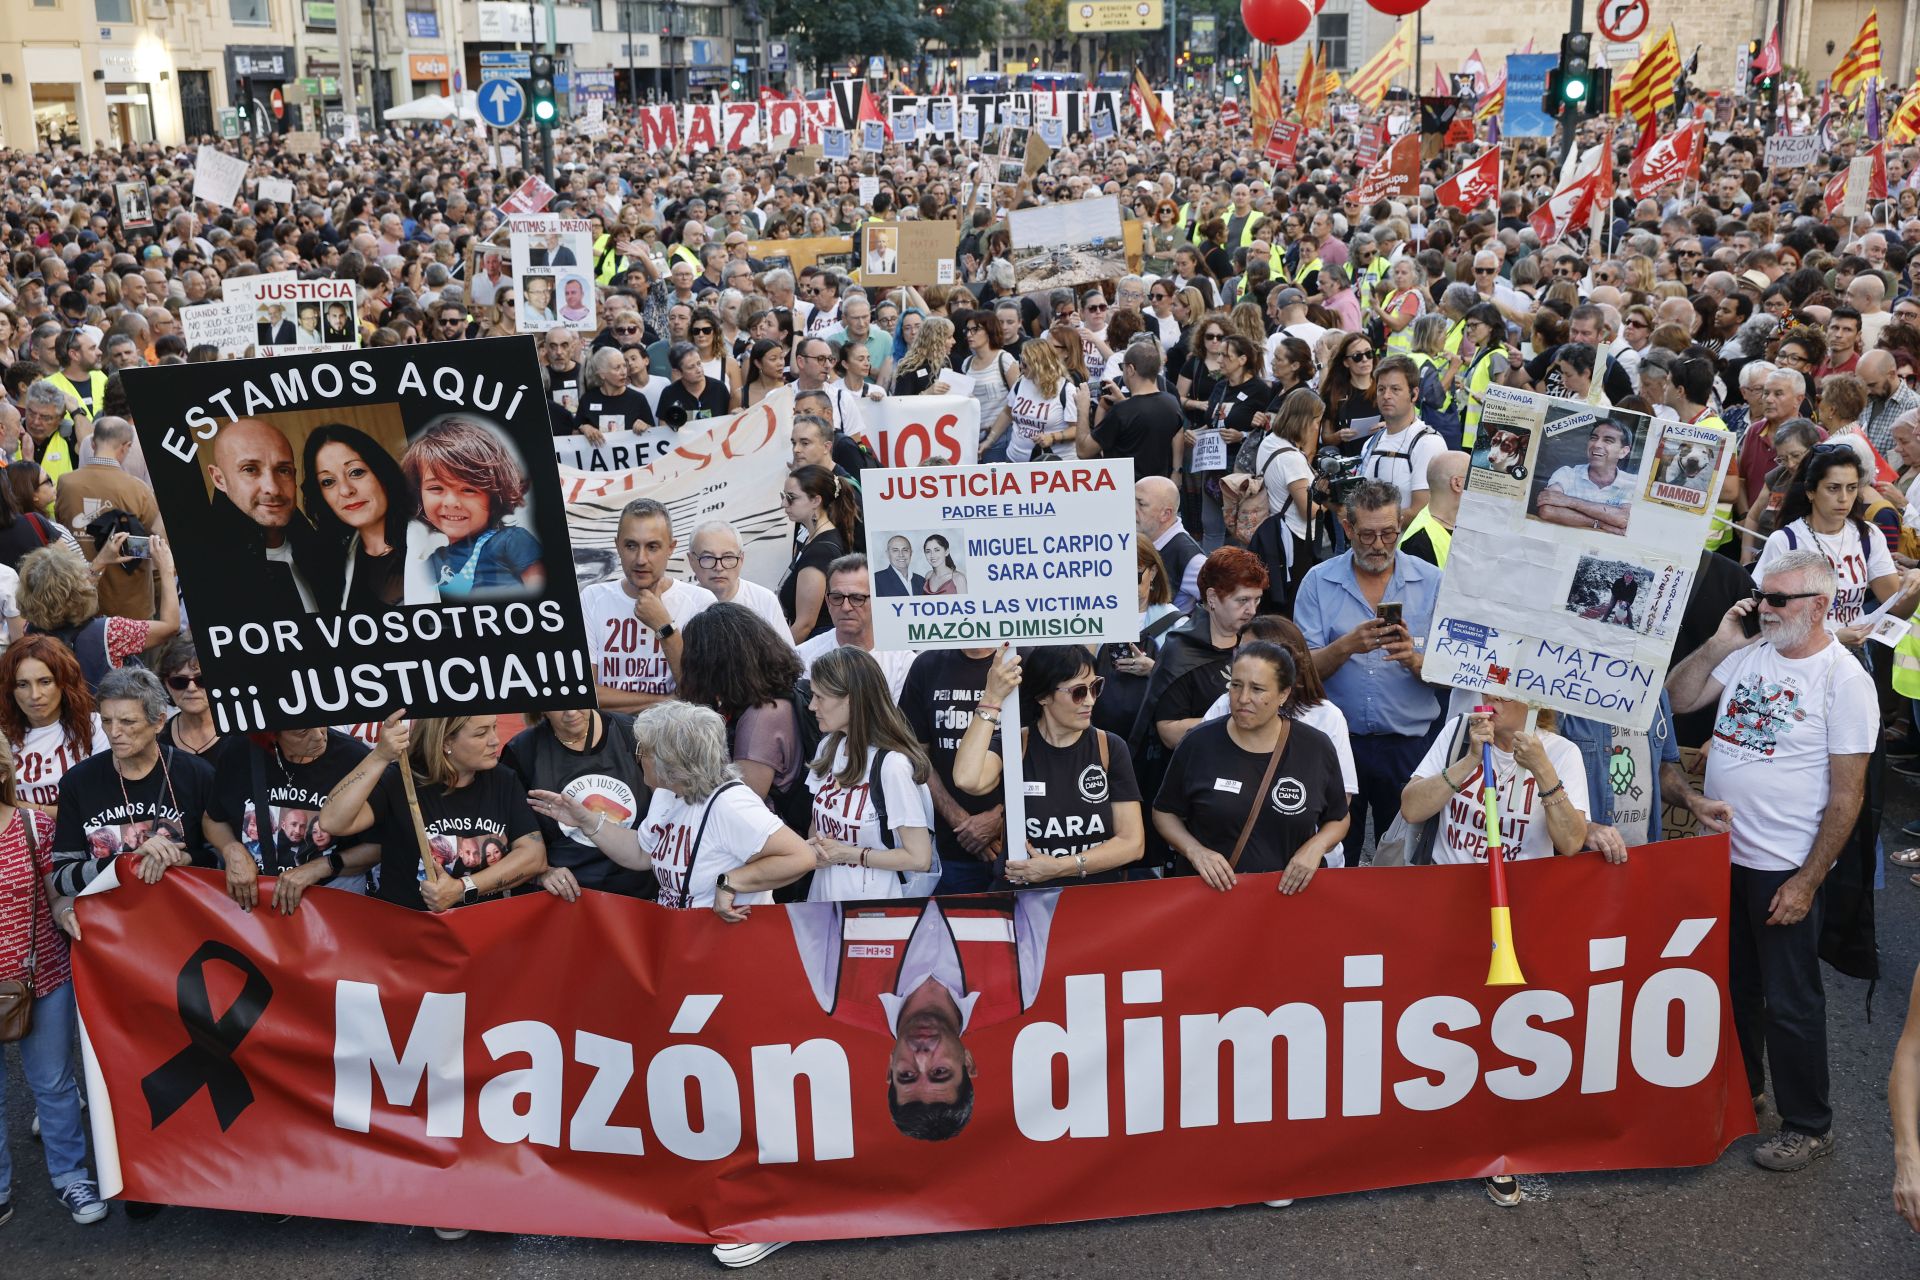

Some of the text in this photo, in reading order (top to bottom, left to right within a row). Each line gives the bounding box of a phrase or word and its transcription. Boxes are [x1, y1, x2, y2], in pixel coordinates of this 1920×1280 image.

[510, 220, 546, 233] VICTIMAS
[255, 283, 353, 300] JUSTICIA
[184, 307, 218, 321] CUANDO
[188, 320, 200, 331] NO
[161, 360, 530, 464] ESTAMOS AQUÍ
[1012, 396, 1050, 420] 20:11
[1546, 413, 1594, 434] ASESINADO
[702, 481, 728, 496] 200
[1030, 468, 1116, 494] PARA
[1656, 484, 1701, 505] MAMBO
[702, 502, 725, 514] 190
[942, 502, 1056, 519] PADRE E HIJA
[968, 532, 1130, 557] MIGUEL CARPIO Y
[987, 559, 1114, 582] SARA CARPIO
[892, 594, 1119, 618] Y TODAS LAS VICTIMAS
[208, 600, 566, 658] POR VOSOTROS
[604, 618, 661, 654] 20:1
[908, 613, 1104, 641] MAZÓN DIMISIÓN
[1436, 638, 1497, 664] RATA
[603, 656, 668, 678] NI OBLIT
[1458, 662, 1484, 676] MAL
[1564, 668, 1592, 683] AL
[934, 690, 986, 702] PER UNA ES
[943, 738, 954, 750] DE
[586, 778, 593, 788] Y
[596, 778, 632, 805] JUSTICIA
[1085, 780, 1104, 790] DANA
[1278, 792, 1300, 800] DANA
[83, 802, 144, 830] ESTAMOS
[1026, 814, 1106, 839] SARA
[1451, 798, 1530, 842] NI OLIT
[474, 818, 506, 838] AQUÍ
[1464, 831, 1522, 861] PEDÓ
[332, 917, 1720, 1163] Mazón dimissió
